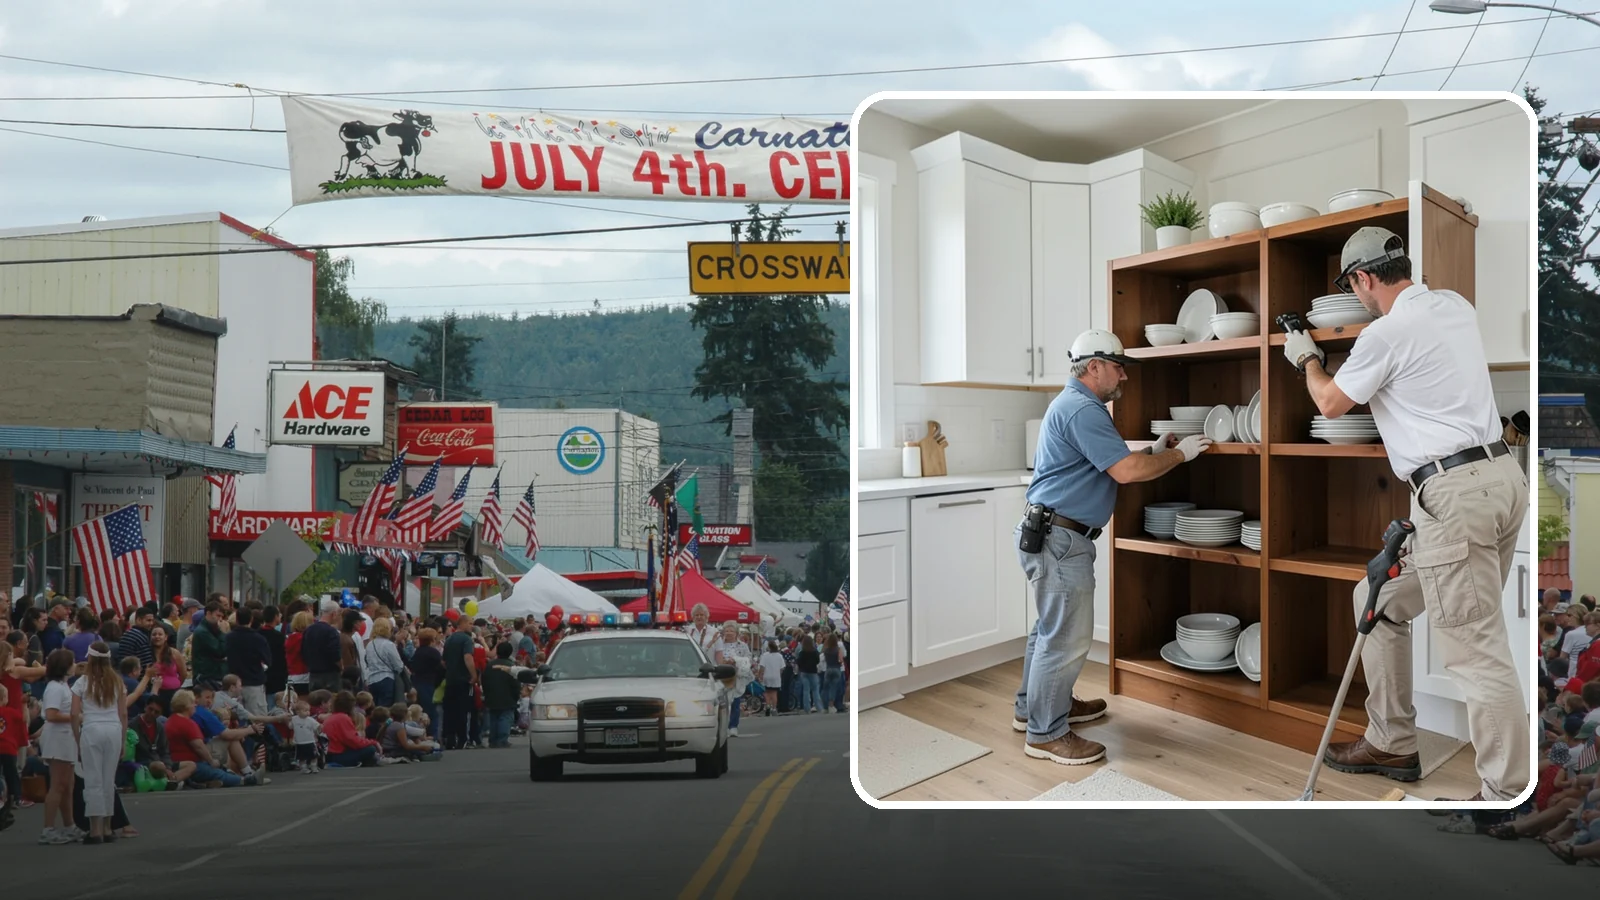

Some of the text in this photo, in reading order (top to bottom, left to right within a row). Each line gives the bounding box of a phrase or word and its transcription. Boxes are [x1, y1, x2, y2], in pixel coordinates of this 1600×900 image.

[481, 141, 605, 192] JULY
[632, 150, 746, 198] 4th.
[697, 254, 850, 280] CROSSWA
[283, 380, 373, 420] ACE
[406, 409, 452, 421] CEDAR
[283, 421, 371, 437] Hardware
[416, 428, 477, 447] Coca-Cola
[83, 484, 155, 495] St. Vincent de Paul
[688, 526, 741, 535] CRNATION
[699, 535, 730, 543] GLASS
